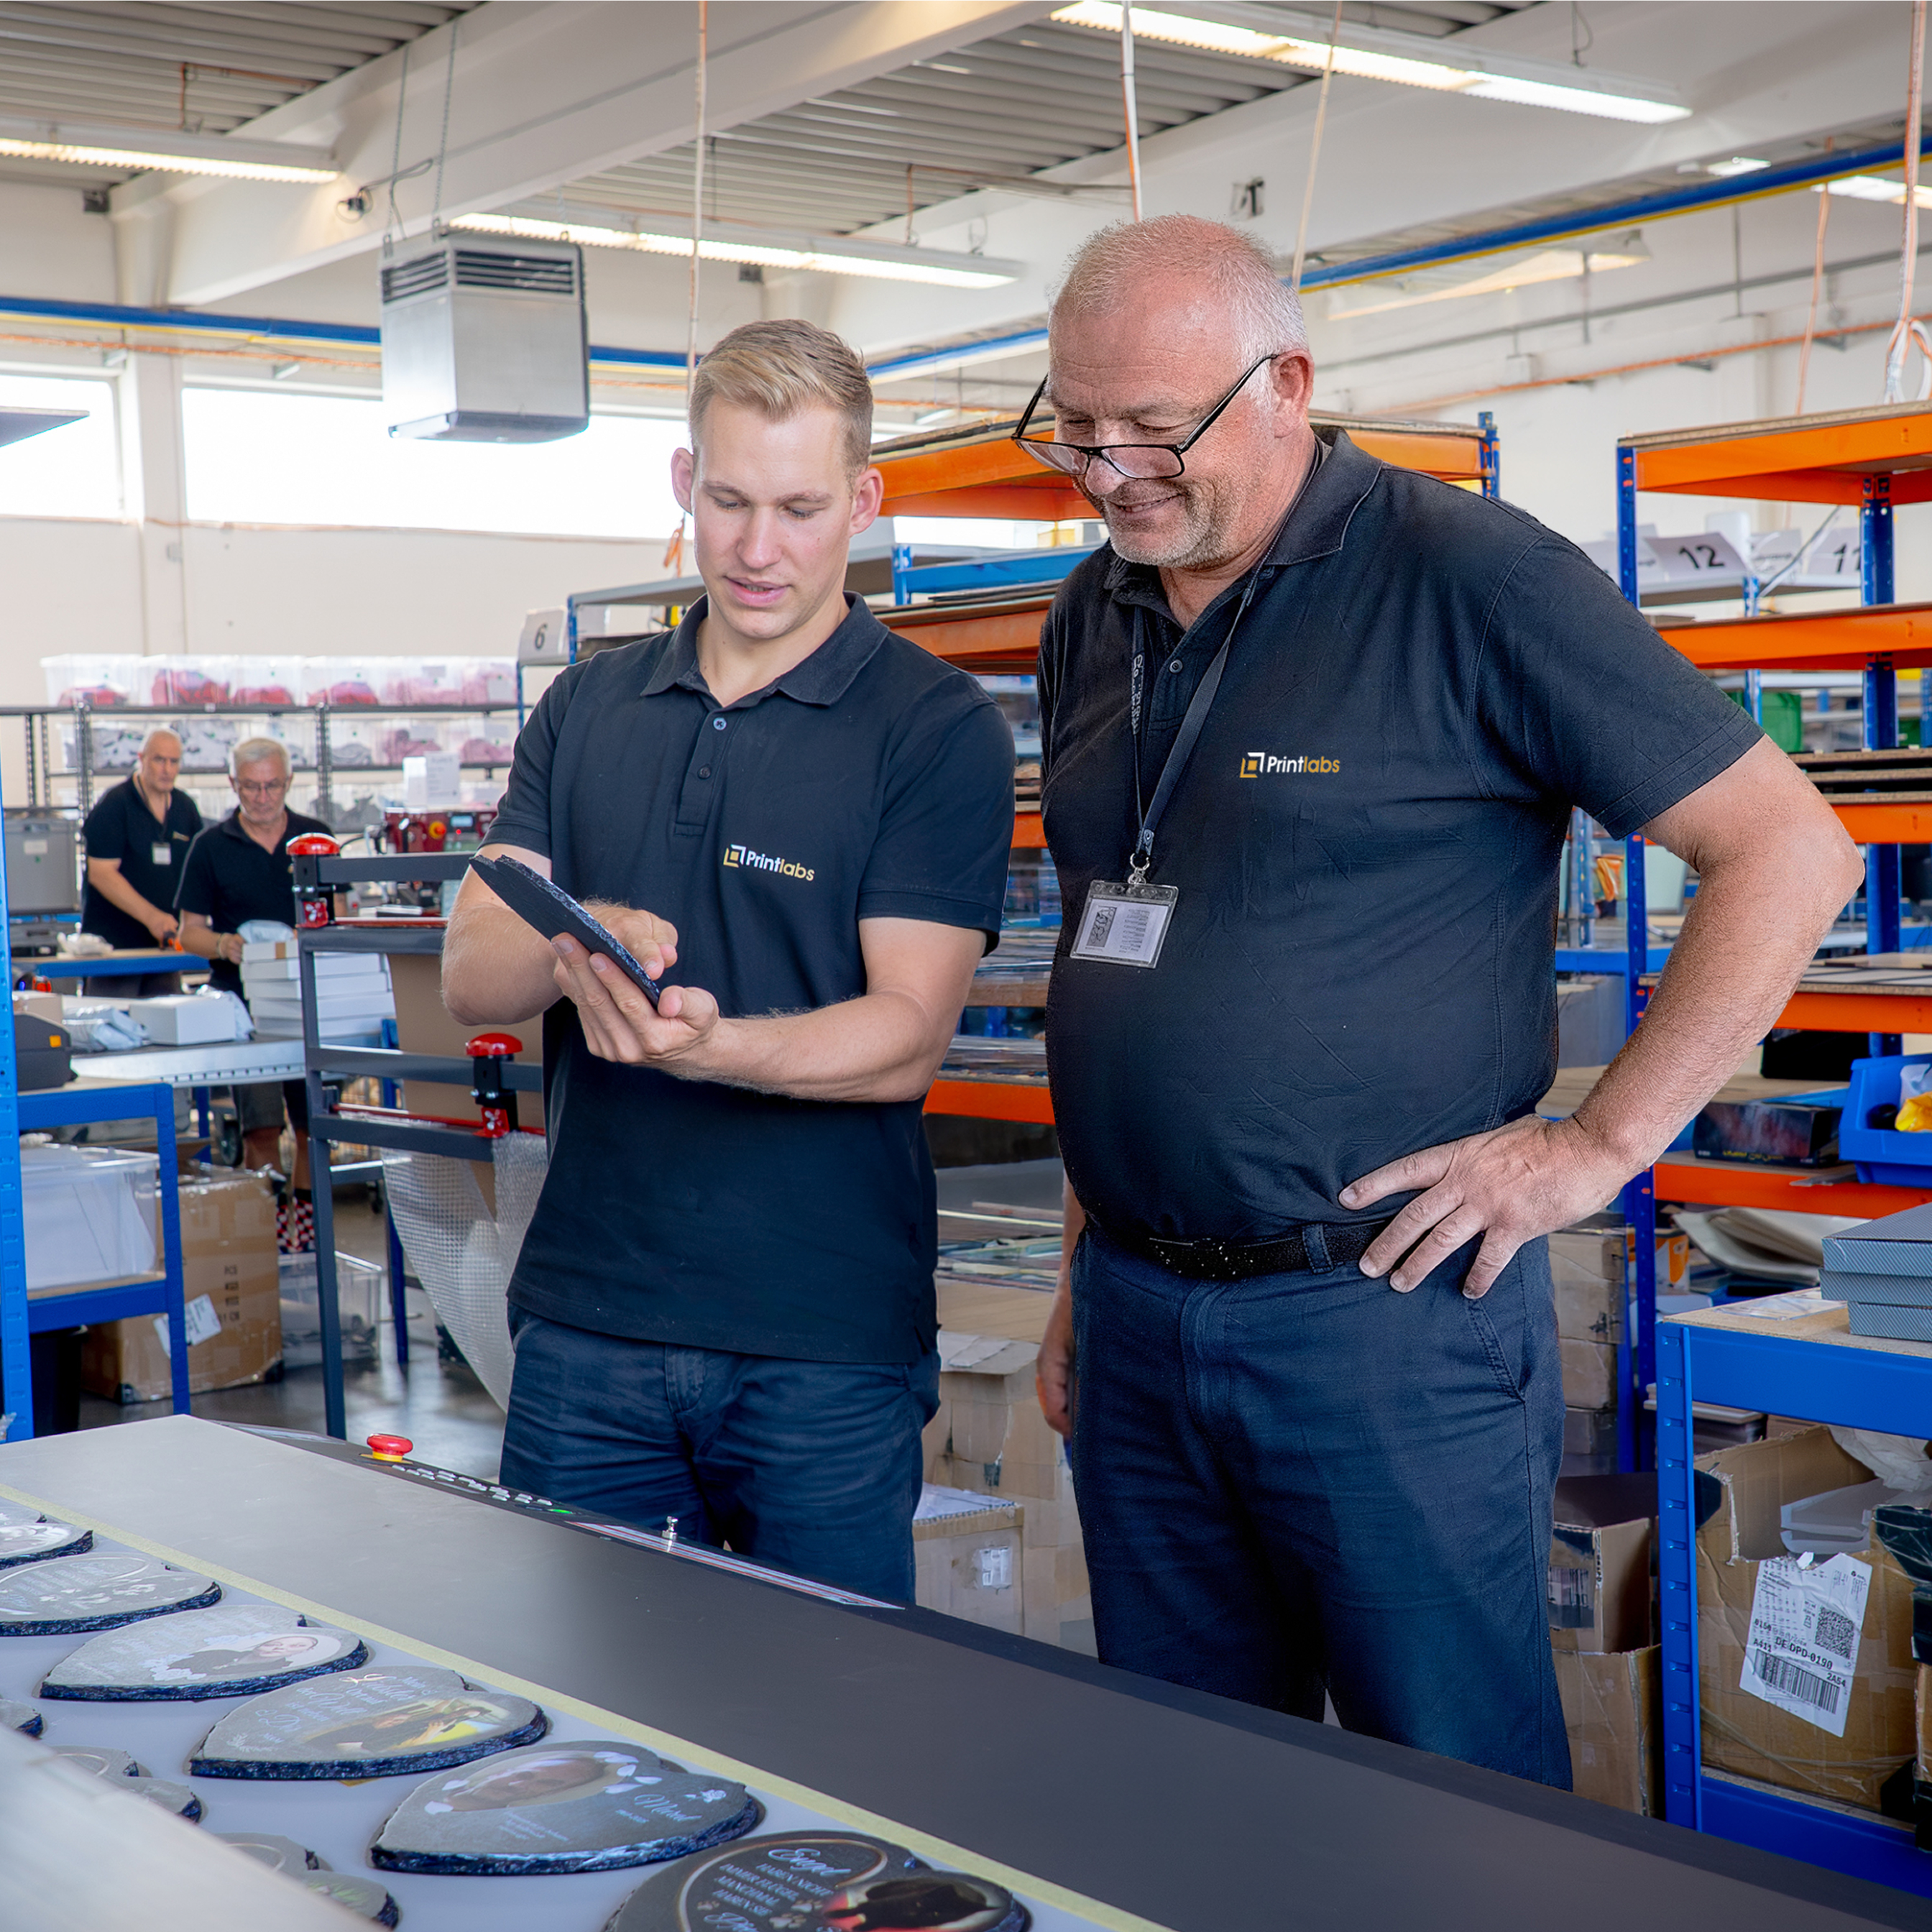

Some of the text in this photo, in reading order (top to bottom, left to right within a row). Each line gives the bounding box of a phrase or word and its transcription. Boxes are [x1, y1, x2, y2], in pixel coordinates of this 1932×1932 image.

[1679, 545, 1724, 570] 12
[534, 622, 548, 650] 6
[1267, 756, 1340, 773] Printlabs
[745, 850, 815, 881] Printlabs
[1826, 1672, 1846, 1688] 2A54
